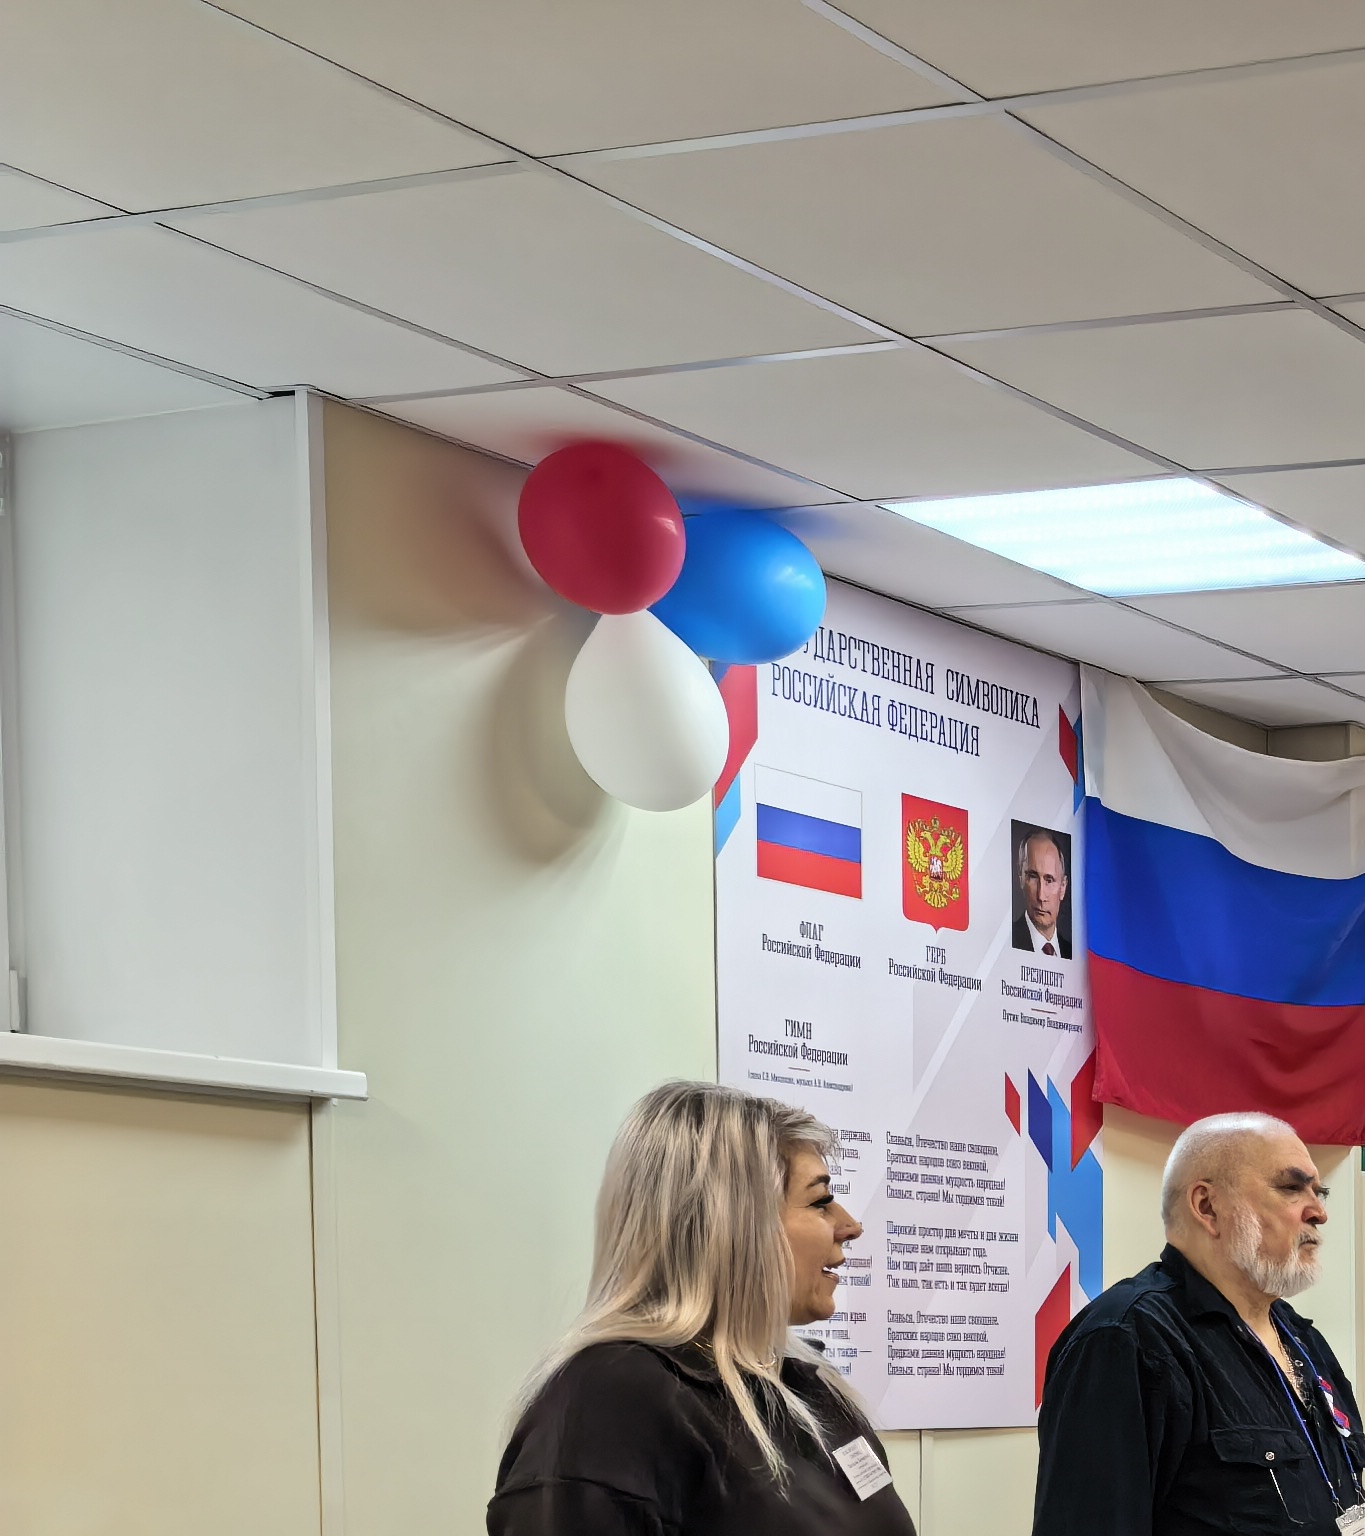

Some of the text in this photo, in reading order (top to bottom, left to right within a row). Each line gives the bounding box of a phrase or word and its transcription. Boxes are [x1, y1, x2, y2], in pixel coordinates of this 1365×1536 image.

[803, 626, 1040, 729] ДАРСТВЕННАЯ СИМВОЛИКА
[771, 662, 980, 757] РОССИЙСКАЯ ФЕДЕРАЦИЯ
[799, 920, 824, 942] ФЛАГ
[762, 933, 861, 969] Российской Федерации
[925, 945, 946, 965] ГЕРБ
[888, 958, 982, 992] Российской Федерации
[1021, 965, 1064, 988] ПРЕЗИДЕНТ
[1001, 979, 1083, 1009] Российской Федерации
[785, 1018, 812, 1040] ГИМН
[748, 1034, 848, 1066] Российской Федерации
